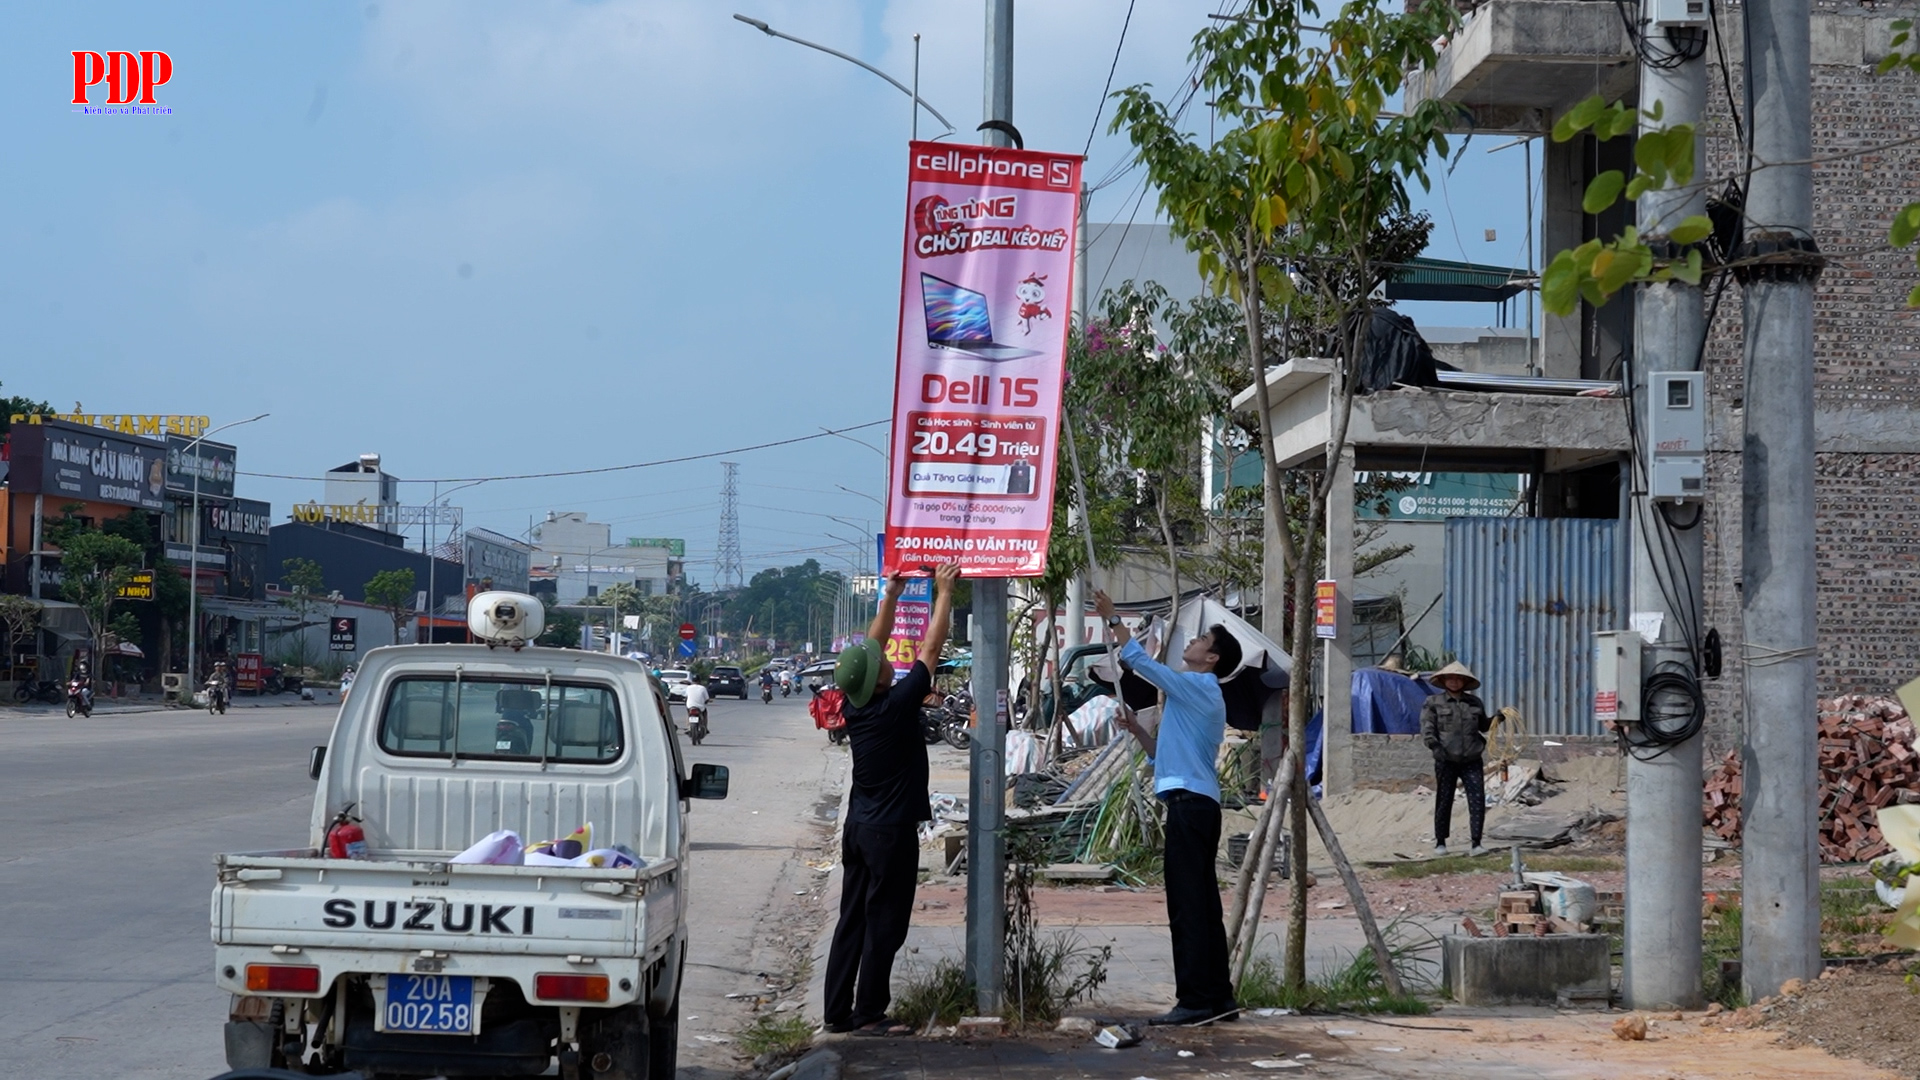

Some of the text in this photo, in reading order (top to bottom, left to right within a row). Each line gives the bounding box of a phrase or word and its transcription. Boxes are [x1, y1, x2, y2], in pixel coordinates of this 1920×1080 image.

[916, 151, 1044, 179] cellphone
[960, 197, 1016, 219] TÙNG
[918, 226, 1067, 254] CHỐT DEAL KẺO HẾT
[921, 373, 1039, 408] Dell 15
[101, 414, 161, 436] SAM
[165, 415, 210, 437] SIP
[918, 418, 932, 427] Giá
[934, 418, 951, 428] Học
[953, 418, 972, 427] sinh
[981, 419, 1001, 429] Sinh
[1003, 420, 1023, 430] viên
[1025, 420, 1036, 430] từ
[912, 431, 1039, 458] 20.49 Triệu
[933, 473, 955, 483] Tặng
[957, 473, 974, 483] Giới
[976, 475, 995, 484] Hạn
[100, 484, 141, 503] RESTAURANT
[292, 499, 325, 526] NỘI
[330, 497, 377, 523] THẤT
[914, 502, 924, 511] Trả
[925, 502, 941, 513] góp
[942, 502, 957, 511] 0%
[940, 514, 996, 524] trong 12 tháng
[895, 535, 1038, 555] 200 HOÀNG VĂN THỤ
[323, 898, 535, 935] SUZUKI
[407, 974, 452, 1001] 20A
[387, 1002, 469, 1030] 002.58
